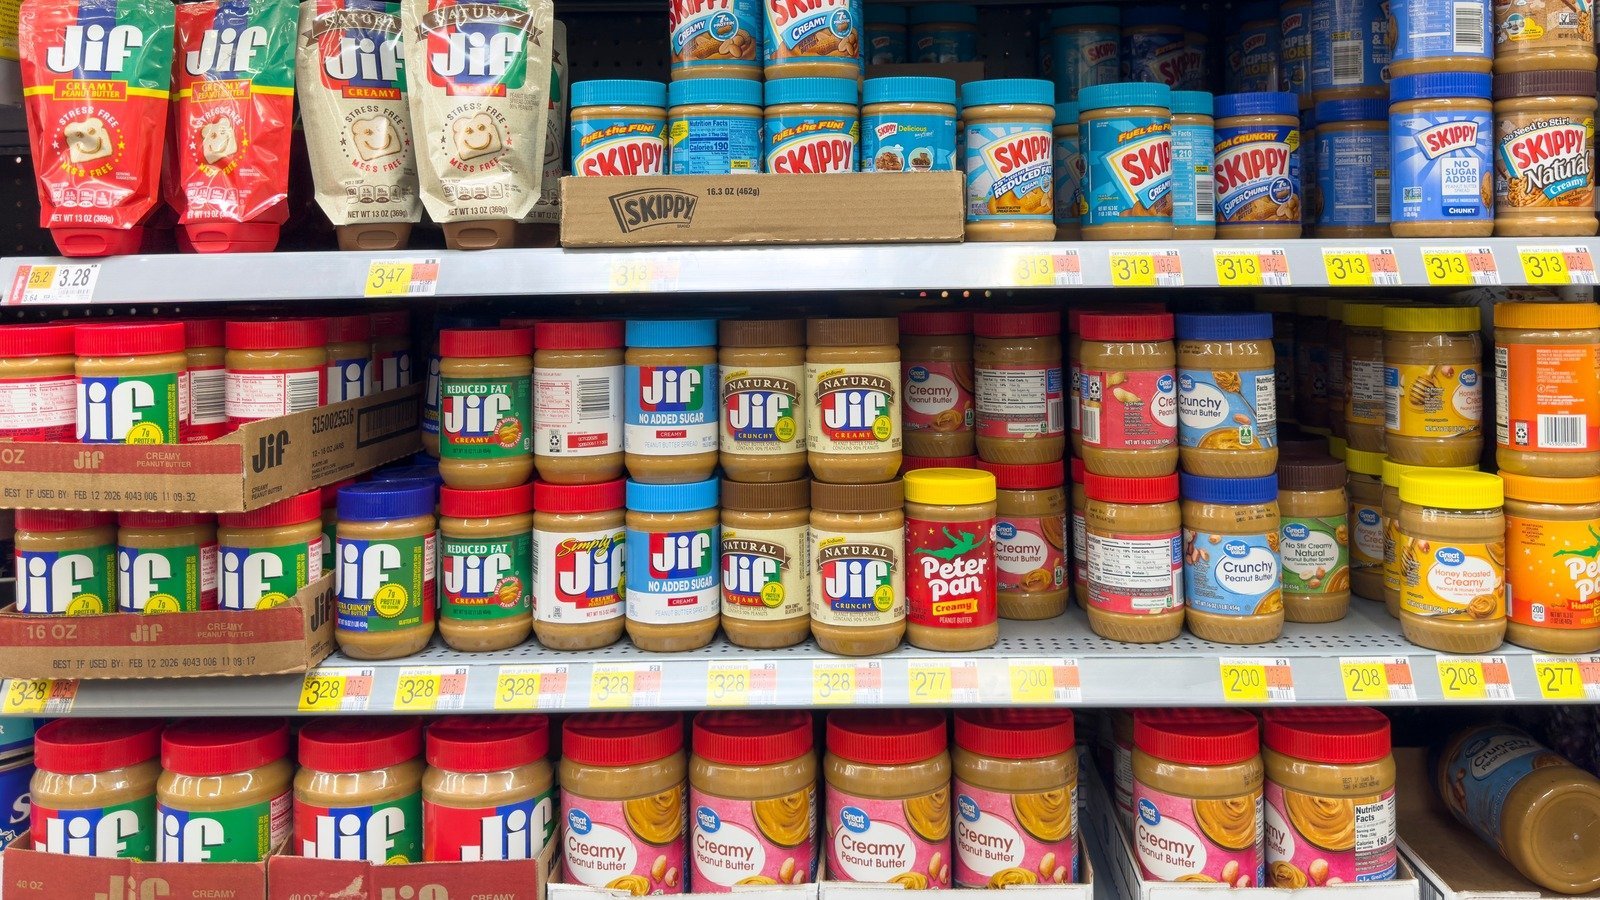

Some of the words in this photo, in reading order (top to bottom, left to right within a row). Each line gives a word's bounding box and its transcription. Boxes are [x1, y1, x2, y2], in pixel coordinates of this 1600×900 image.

[792, 16, 827, 40] CREAMY
[46, 24, 144, 73] Jif
[186, 27, 268, 76] Jif
[66, 82, 115, 91] CREAMY
[348, 88, 396, 98] CREAMY
[60, 105, 95, 126] STRESS
[98, 109, 119, 128] FREE
[345, 105, 379, 123] STRESS
[383, 109, 404, 127] FREE
[877, 123, 897, 136] SKIPPY
[898, 125, 928, 133] Delicious
[1502, 133, 1514, 144] No
[1514, 122, 1537, 136] Need
[1537, 120, 1548, 130] to
[1549, 116, 1570, 126] Stir!
[1426, 125, 1476, 152] SKIPPY
[690, 143, 714, 152] Calories
[714, 141, 729, 151] 190
[1178, 149, 1192, 158] 210
[1512, 129, 1584, 169] SKIPPY
[994, 135, 1051, 173] SKIPPY
[1357, 155, 1372, 163] 210
[449, 157, 476, 173] MESS
[479, 157, 500, 172] FREE
[1214, 147, 1288, 195] SKIPPY
[1454, 160, 1470, 168] NO
[1523, 149, 1591, 195] Natural
[1445, 176, 1477, 184] ADDED
[1550, 177, 1584, 196] Creamy
[707, 187, 723, 196] 16.3
[724, 187, 736, 196] OZ
[737, 187, 760, 197] (462g)
[628, 195, 695, 226] SKIPPY
[1449, 207, 1476, 215] CHUNKY
[51, 213, 63, 222] NET
[63, 213, 74, 222] WT
[75, 213, 83, 222] 13
[84, 213, 92, 222] OZ
[93, 213, 114, 225] (369g)
[59, 268, 92, 288] 3.28
[447, 385, 488, 395] REDUCED
[490, 383, 508, 394] FAT
[642, 368, 702, 405] Jif
[729, 379, 790, 392] NATURAL
[823, 376, 886, 390] NATURAL
[908, 384, 952, 399] Creamy
[908, 396, 931, 404] Peanut
[932, 396, 953, 404] Butter
[444, 393, 512, 434] Jif
[639, 413, 650, 424] NO
[650, 413, 679, 425] ADDED
[680, 412, 705, 424] SUGAR
[312, 407, 354, 435] 5150025516
[660, 431, 682, 439] CREAMY
[738, 432, 774, 440] CRUNCHY
[1, 448, 25, 465] OZ
[146, 451, 181, 461] CREAMY
[251, 429, 290, 474] Jif
[73, 450, 105, 470] Jif
[136, 460, 165, 468] PEANUT
[165, 460, 192, 469] BUTTER
[4, 488, 22, 498] BEST
[25, 488, 36, 498] IF
[37, 489, 55, 499] USED
[74, 490, 88, 500] FEB
[91, 490, 100, 500] 12
[104, 490, 121, 501] 2026
[124, 491, 142, 501] 4043
[143, 491, 158, 501] 006
[1285, 525, 1306, 535] Great
[447, 544, 488, 555] REDUCED
[490, 543, 508, 554] FAT
[556, 536, 611, 558] Simply
[651, 534, 711, 573] Jif
[722, 543, 777, 556] NATURAL
[824, 545, 888, 559] NATURAL
[995, 541, 1041, 558] Creamy
[1225, 542, 1246, 552] Great
[1294, 549, 1326, 557] Natural
[1307, 542, 1333, 551] Creamy
[1438, 548, 1462, 559] Great
[444, 553, 512, 594] Jif
[920, 556, 988, 581] Peter
[1222, 560, 1274, 577] Crunchy
[1435, 570, 1460, 579] Honey
[1462, 569, 1491, 578] Roasted
[648, 581, 661, 592] NO
[661, 579, 690, 592] ADDED
[690, 576, 714, 590] SUGAR
[1224, 574, 1253, 583] Peanut
[1254, 573, 1273, 582] Butter
[1443, 577, 1485, 589] Creamy
[927, 574, 983, 603] Pan
[454, 597, 490, 605] CREAMY
[835, 602, 873, 610] CRUNCHY
[935, 601, 974, 614] Creamy
[207, 622, 244, 632] CREAMY
[939, 616, 955, 624] PEANUT
[956, 616, 973, 624] BUTTER
[27, 624, 47, 640] 16
[51, 623, 78, 640] OZ
[130, 623, 164, 643] Jif
[53, 659, 72, 670] BEST
[76, 659, 87, 669] IF
[89, 659, 108, 669] USED
[128, 658, 144, 668] FEB
[147, 657, 157, 668] 12
[160, 657, 179, 668] 2026
[182, 656, 201, 667] 4043
[202, 656, 218, 666] 006
[1355, 804, 1384, 815] Nutrition
[842, 810, 865, 824] Great
[1355, 814, 1376, 823] Facts
[847, 819, 865, 830] Value
[958, 821, 1014, 853] Creamy
[1138, 824, 1196, 859] Creamy
[1356, 840, 1375, 848] Calories
[568, 836, 626, 862] Creamy
[696, 833, 755, 860] Creamy
[841, 834, 906, 860] Creamy
[568, 855, 596, 870] Peanut
[596, 859, 627, 872] Butter
[696, 851, 724, 868] Peanut
[724, 858, 755, 872] Butter
[841, 851, 873, 868] Peanut
[874, 858, 906, 870] Butter
